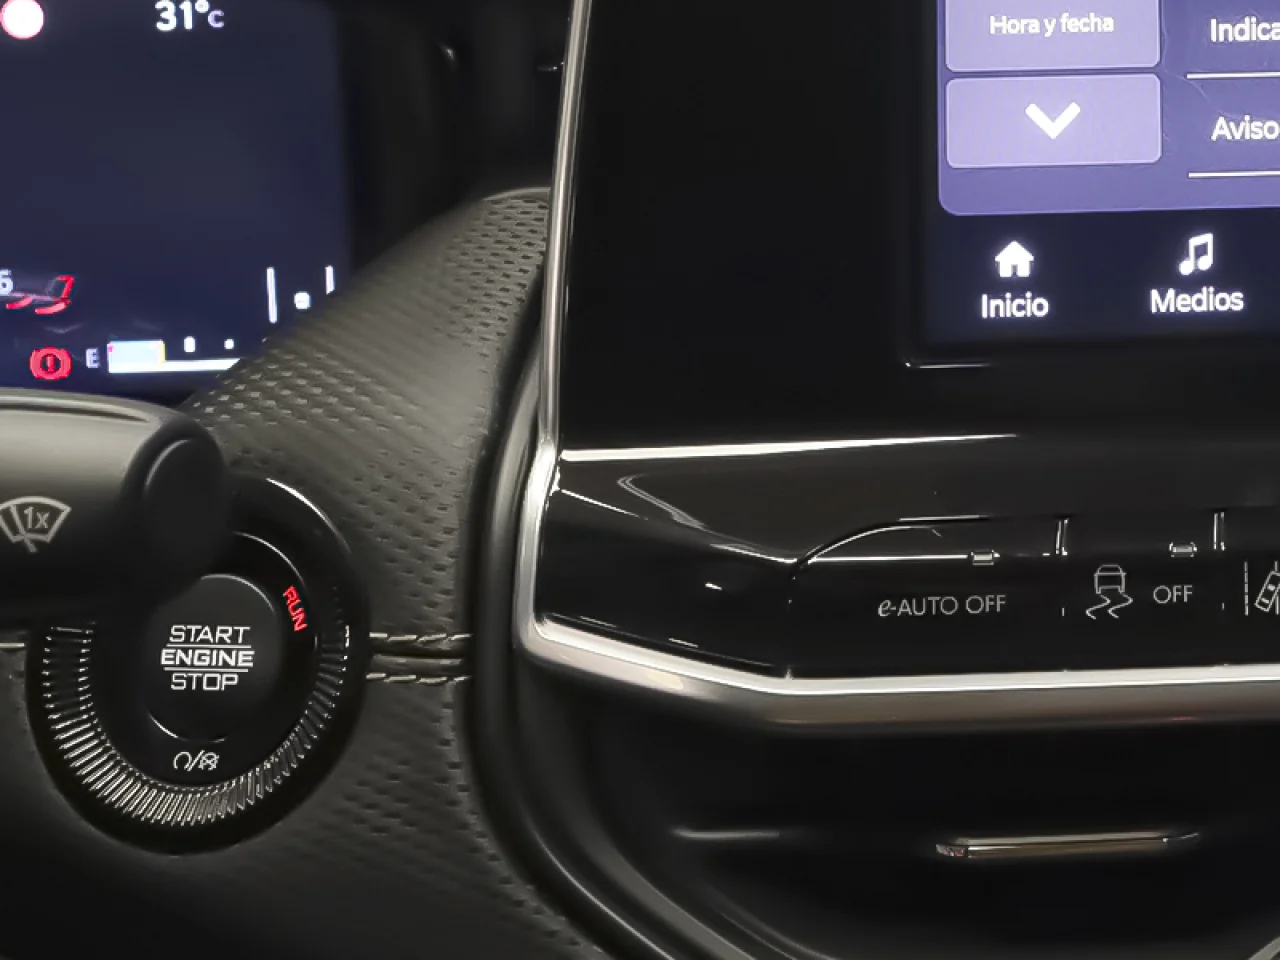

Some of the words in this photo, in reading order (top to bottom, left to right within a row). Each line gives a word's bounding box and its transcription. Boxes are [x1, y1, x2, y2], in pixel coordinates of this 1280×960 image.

[989, 15, 1040, 34] Hora
[1042, 18, 1056, 37] y
[1058, 12, 1114, 32] fecha
[1210, 114, 1280, 141] Aviso
[981, 291, 1048, 318] Inicio
[1150, 285, 1244, 313] Medios
[965, 594, 1005, 613] OFF
[1152, 584, 1192, 603] OFF
[282, 585, 307, 631] RUN
[169, 625, 252, 644] START
[160, 648, 256, 667] ENGINE
[170, 672, 239, 691] STOP
